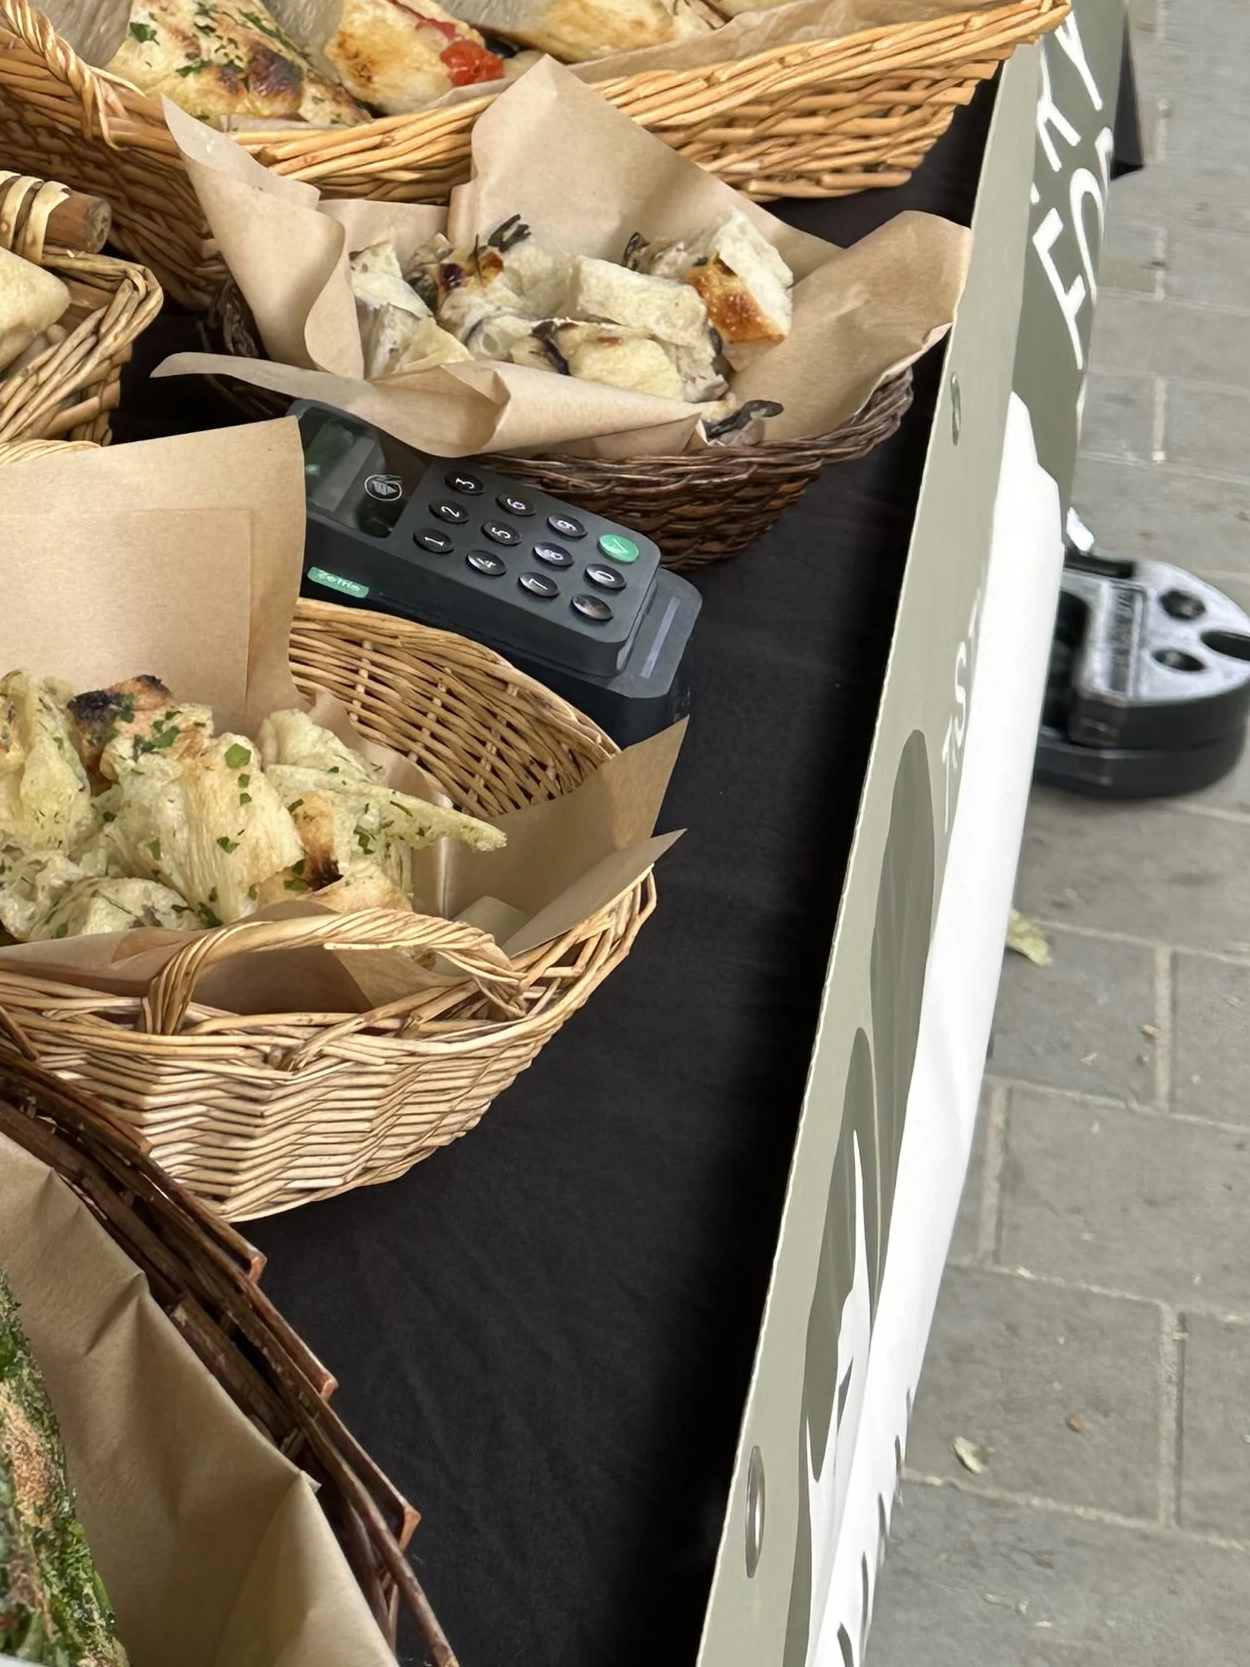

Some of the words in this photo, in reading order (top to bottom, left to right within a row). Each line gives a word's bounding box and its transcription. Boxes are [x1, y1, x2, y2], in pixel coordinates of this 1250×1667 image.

[424, 536, 445, 547] 1
[440, 505, 460, 518] 2
[455, 477, 475, 490] 3
[491, 526, 511, 540] 5
[506, 497, 526, 511] 6
[557, 519, 578, 532] 9
